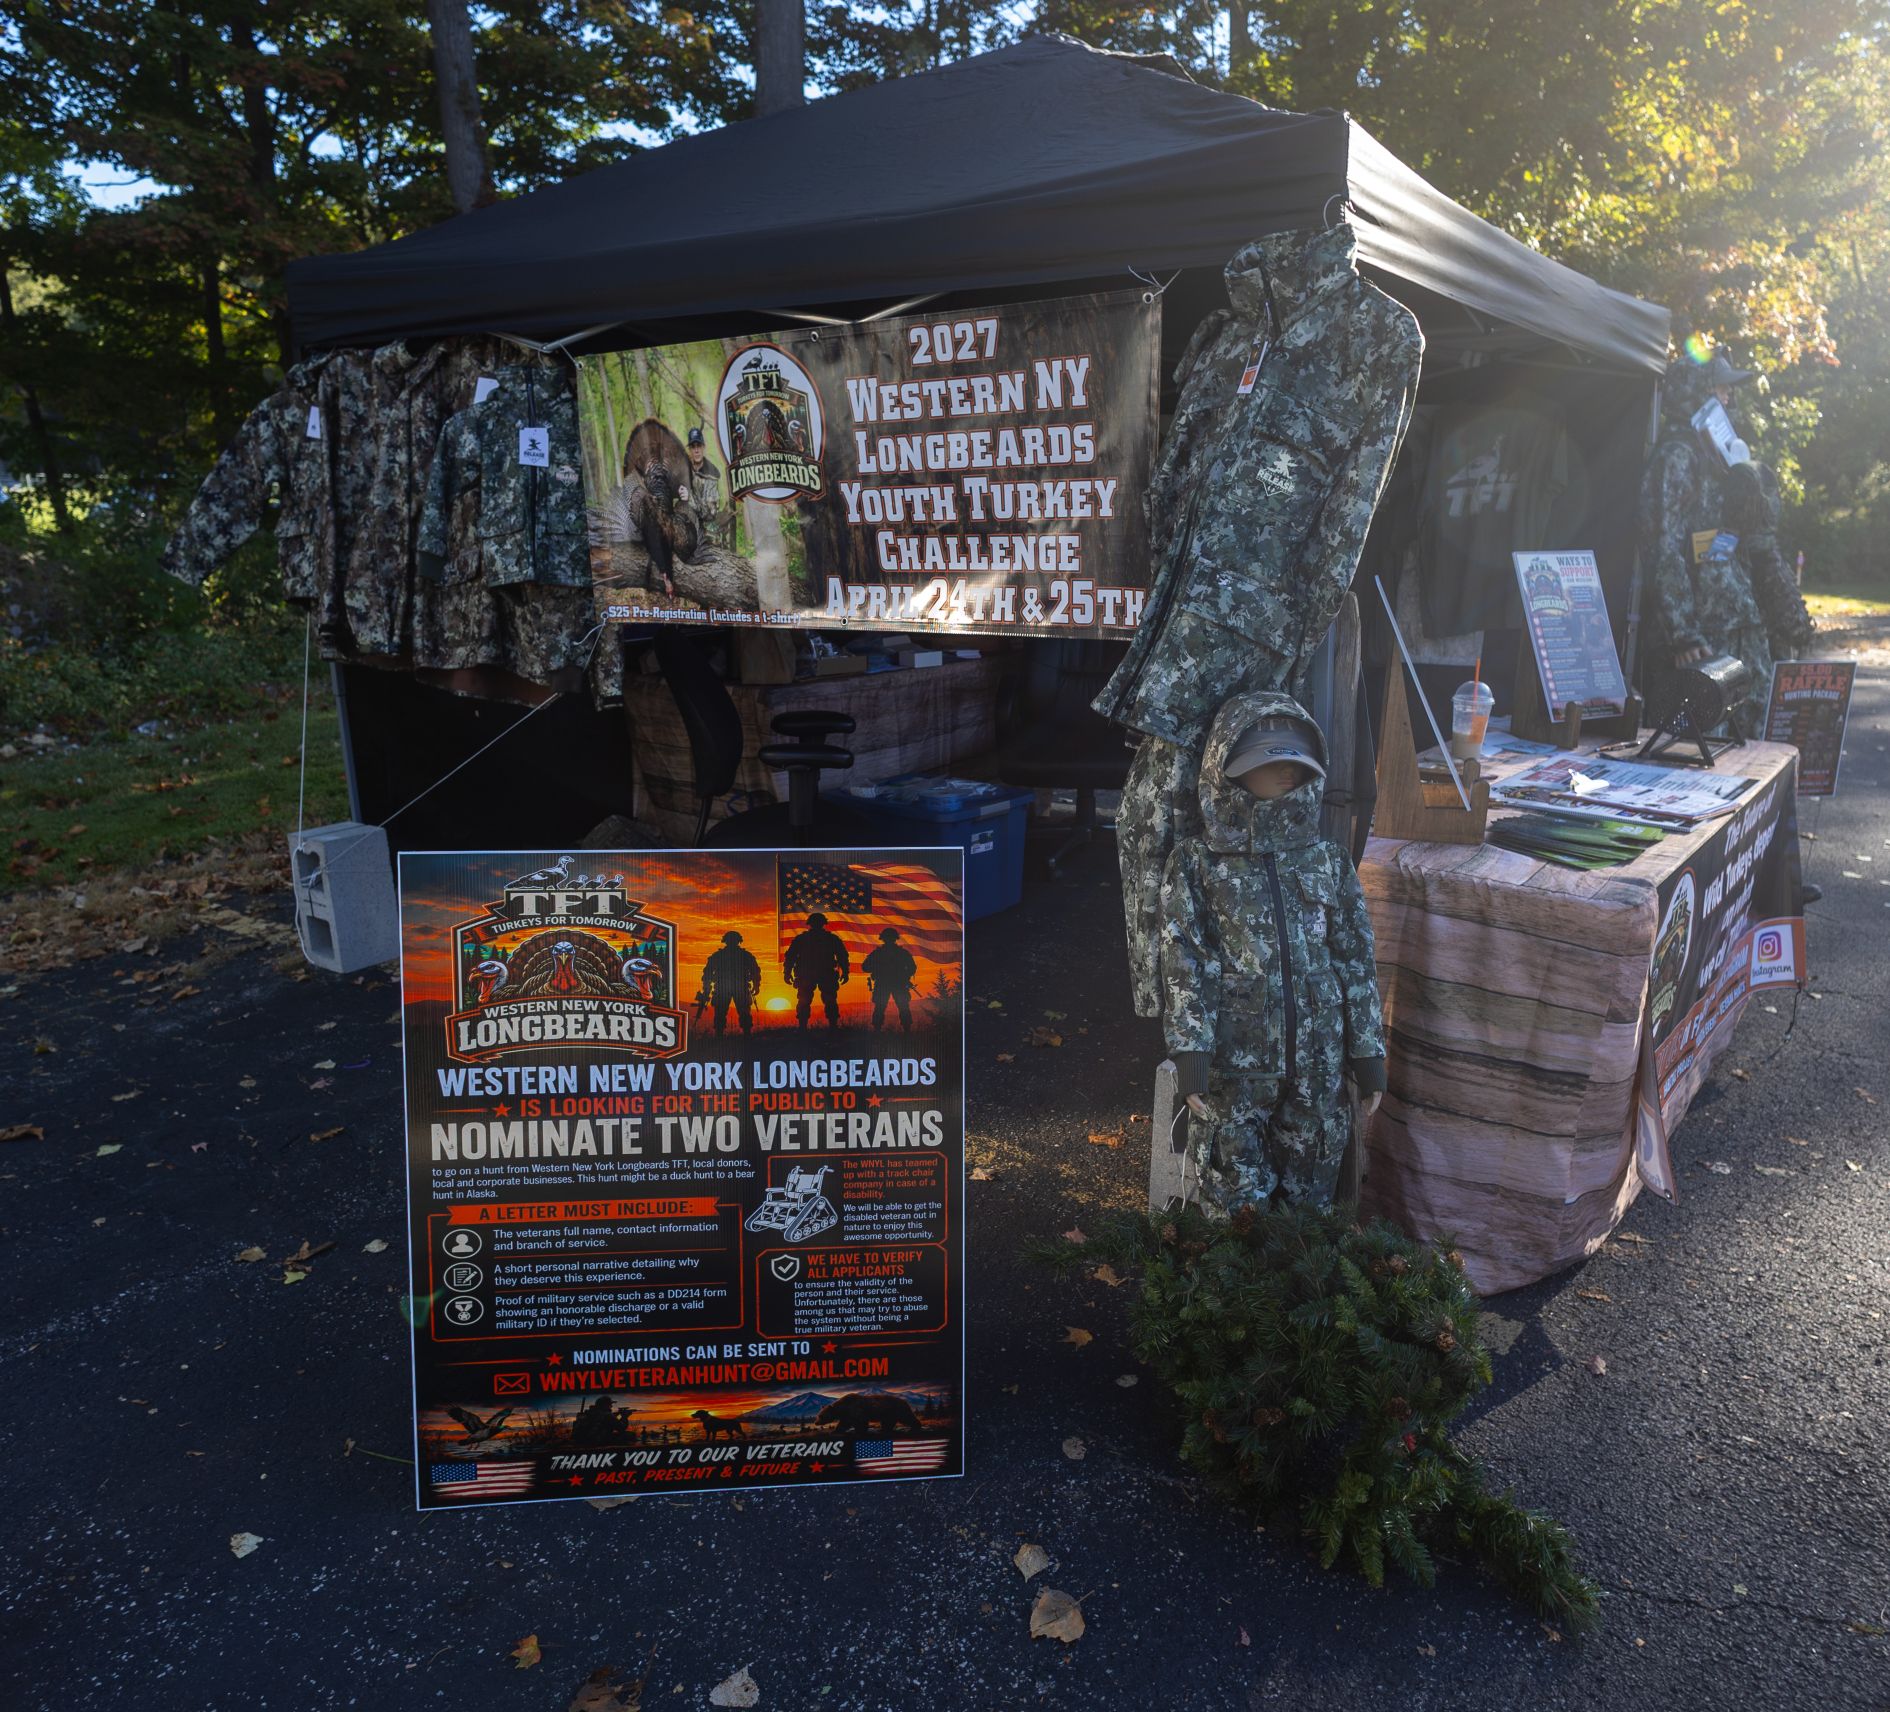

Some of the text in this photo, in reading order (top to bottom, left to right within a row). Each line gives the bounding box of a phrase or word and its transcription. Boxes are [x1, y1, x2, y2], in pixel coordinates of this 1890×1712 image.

[908, 317, 999, 366] 2027
[743, 371, 780, 392] TFT
[846, 356, 1091, 424] WESTERN NY
[740, 453, 803, 466] WESTERN NEW YORK
[854, 423, 1096, 475] LONGBEARDS
[730, 463, 821, 493] LONGBEARDS
[839, 475, 1118, 524] YOUTH TURKEY
[876, 529, 1082, 573] CHALLENGE
[1556, 556, 1593, 566] WAYS TO
[1559, 566, 1594, 577] SUPPORT
[825, 575, 1146, 627] APRIL 24TH & 25TH
[632, 606, 707, 621] Pre-Registration
[709, 608, 752, 623] (Includes
[754, 613, 761, 623] a
[762, 611, 801, 624] t-shirt)
[1779, 675, 1848, 692] RAFFLE
[510, 891, 622, 916] TFT
[1703, 871, 1725, 919] Wild
[491, 916, 638, 934] TURKEYS FOR TOMORROW
[484, 999, 646, 1019] WESTERN NEW YORK
[458, 1013, 676, 1051] LONGBEARDS
[436, 1057, 936, 1097] WESTERN NEW YORK LONGBEARDS
[520, 1090, 856, 1117] IS LOOKING FOR THE PUBLIC TO
[430, 1109, 943, 1161] NOMINATE TWO VETERANS
[431, 1158, 751, 1178] to go on a hunt from Western New York Longbeards TFT, local donors,
[432, 1178, 455, 1188] local
[456, 1177, 474, 1188] and
[475, 1176, 521, 1187] corporate
[522, 1175, 575, 1185] businesses.
[576, 1173, 596, 1183] This
[597, 1173, 618, 1182] hunt
[620, 1172, 646, 1183] might
[647, 1171, 660, 1181] be
[669, 1170, 692, 1180] duck
[693, 1170, 714, 1180] hunt
[715, 1170, 726, 1179] to
[726, 1171, 733, 1179] a
[735, 1169, 755, 1179] bear
[432, 1188, 498, 1200] hunt in Alaska.
[479, 1200, 692, 1221] A LETTER MUST INCLUDE:
[492, 1221, 719, 1238] The veterans full name, contact information
[493, 1237, 608, 1251] and branch of service.
[493, 1256, 699, 1274] A short personal narrative detailing why
[806, 1250, 922, 1265] WE HAVE TO VERIFY
[494, 1271, 645, 1287] they deserve this experience.
[807, 1263, 904, 1278] ALL APPLICANTS
[494, 1287, 727, 1306] Proof of military service such as a DD214 form
[495, 1299, 704, 1318] showing an honorable discharge or a valid
[573, 1340, 810, 1365] NOMINATIONS CAN BE SENT TO
[539, 1356, 889, 1391] WNYLVETERANHUNT@GMAIL.COM
[550, 1440, 844, 1469] THANK YOU TO OUR VETERANS
[593, 1461, 801, 1485] PAST, PRESENT & FUTURE
